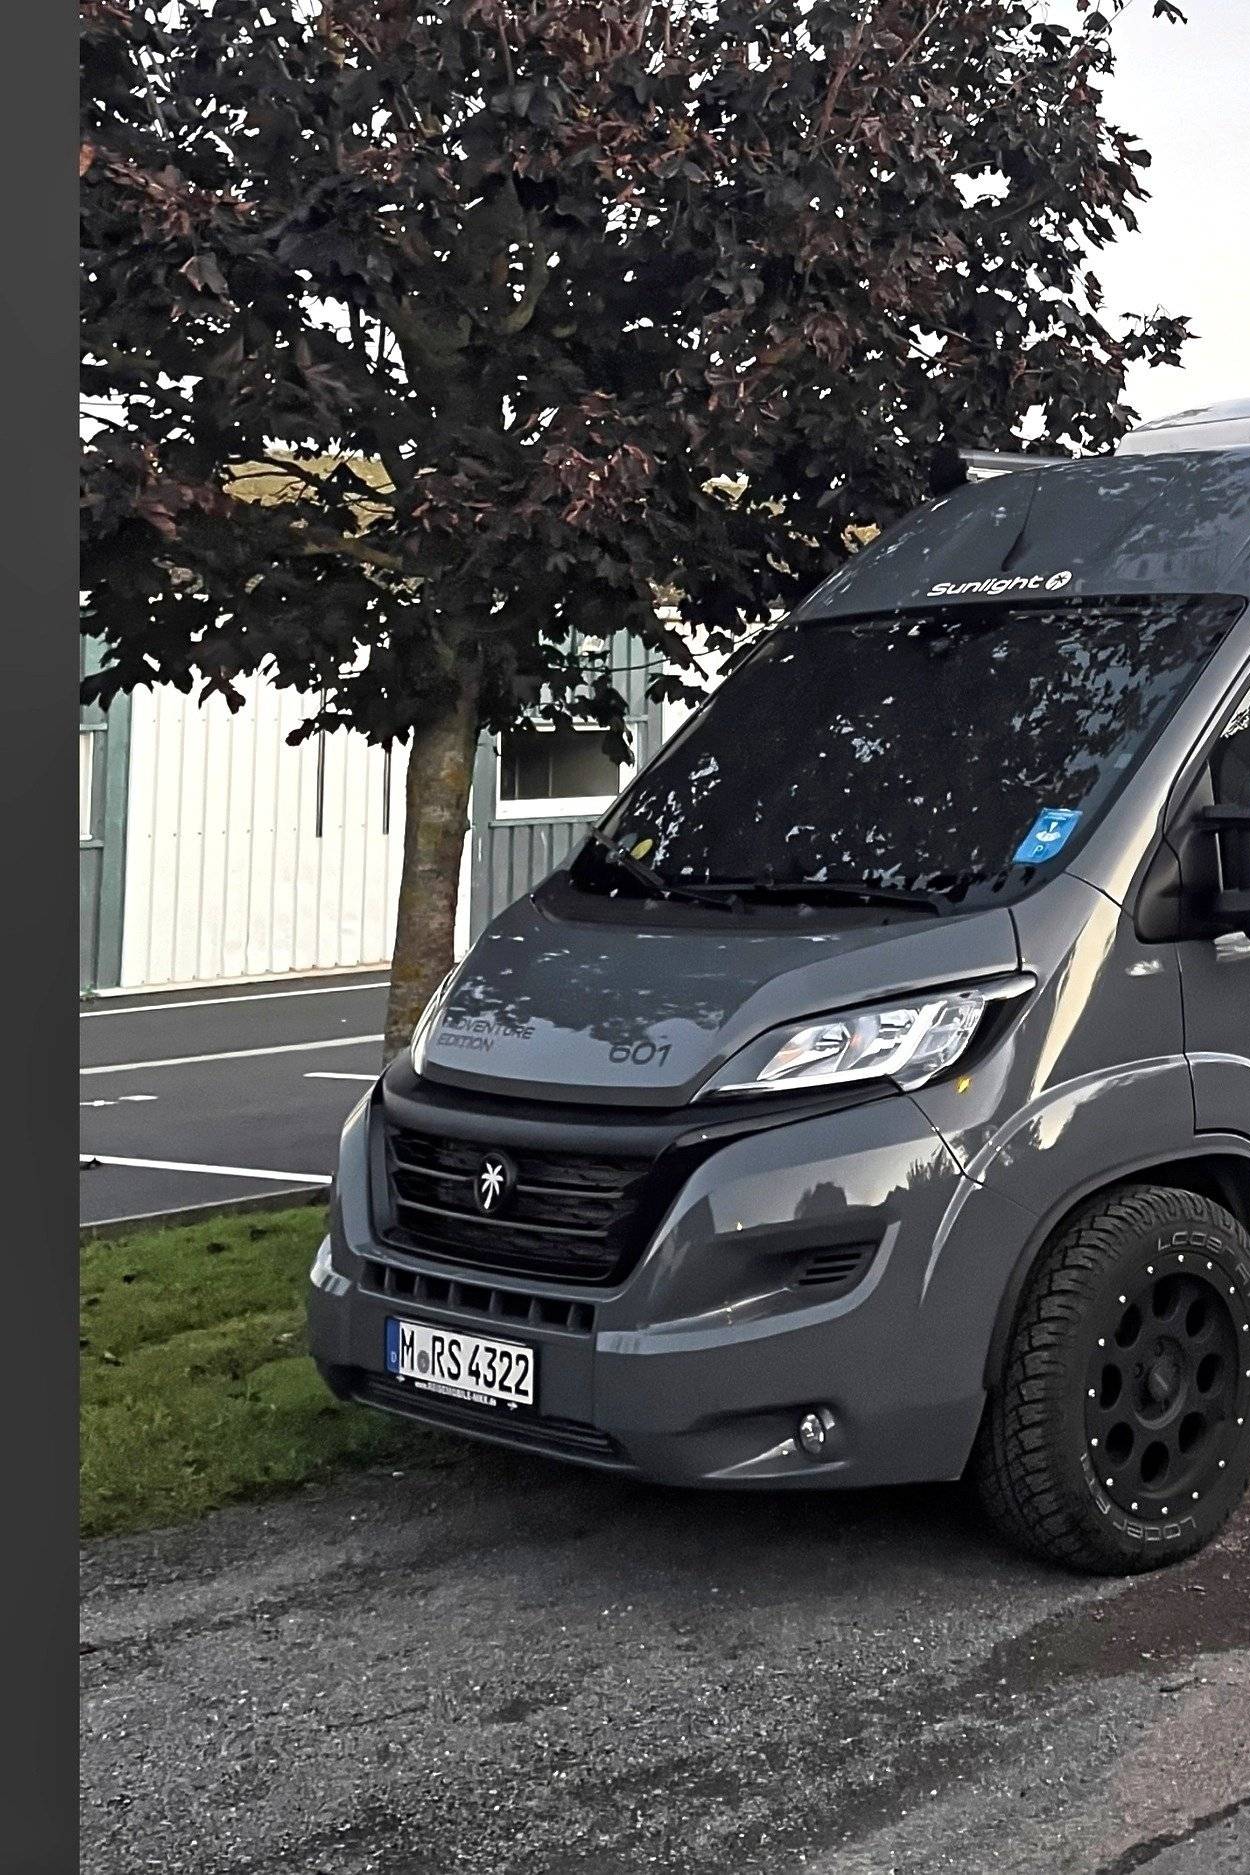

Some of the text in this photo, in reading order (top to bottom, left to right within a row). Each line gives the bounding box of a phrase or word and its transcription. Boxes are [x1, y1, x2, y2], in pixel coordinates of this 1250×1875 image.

[926, 575, 1044, 597] Sunlight
[437, 1034, 494, 1053] EDITION
[608, 1041, 673, 1068] 601
[401, 1327, 415, 1371] M
[431, 1335, 462, 1381] RS
[468, 1344, 530, 1398] 4322
